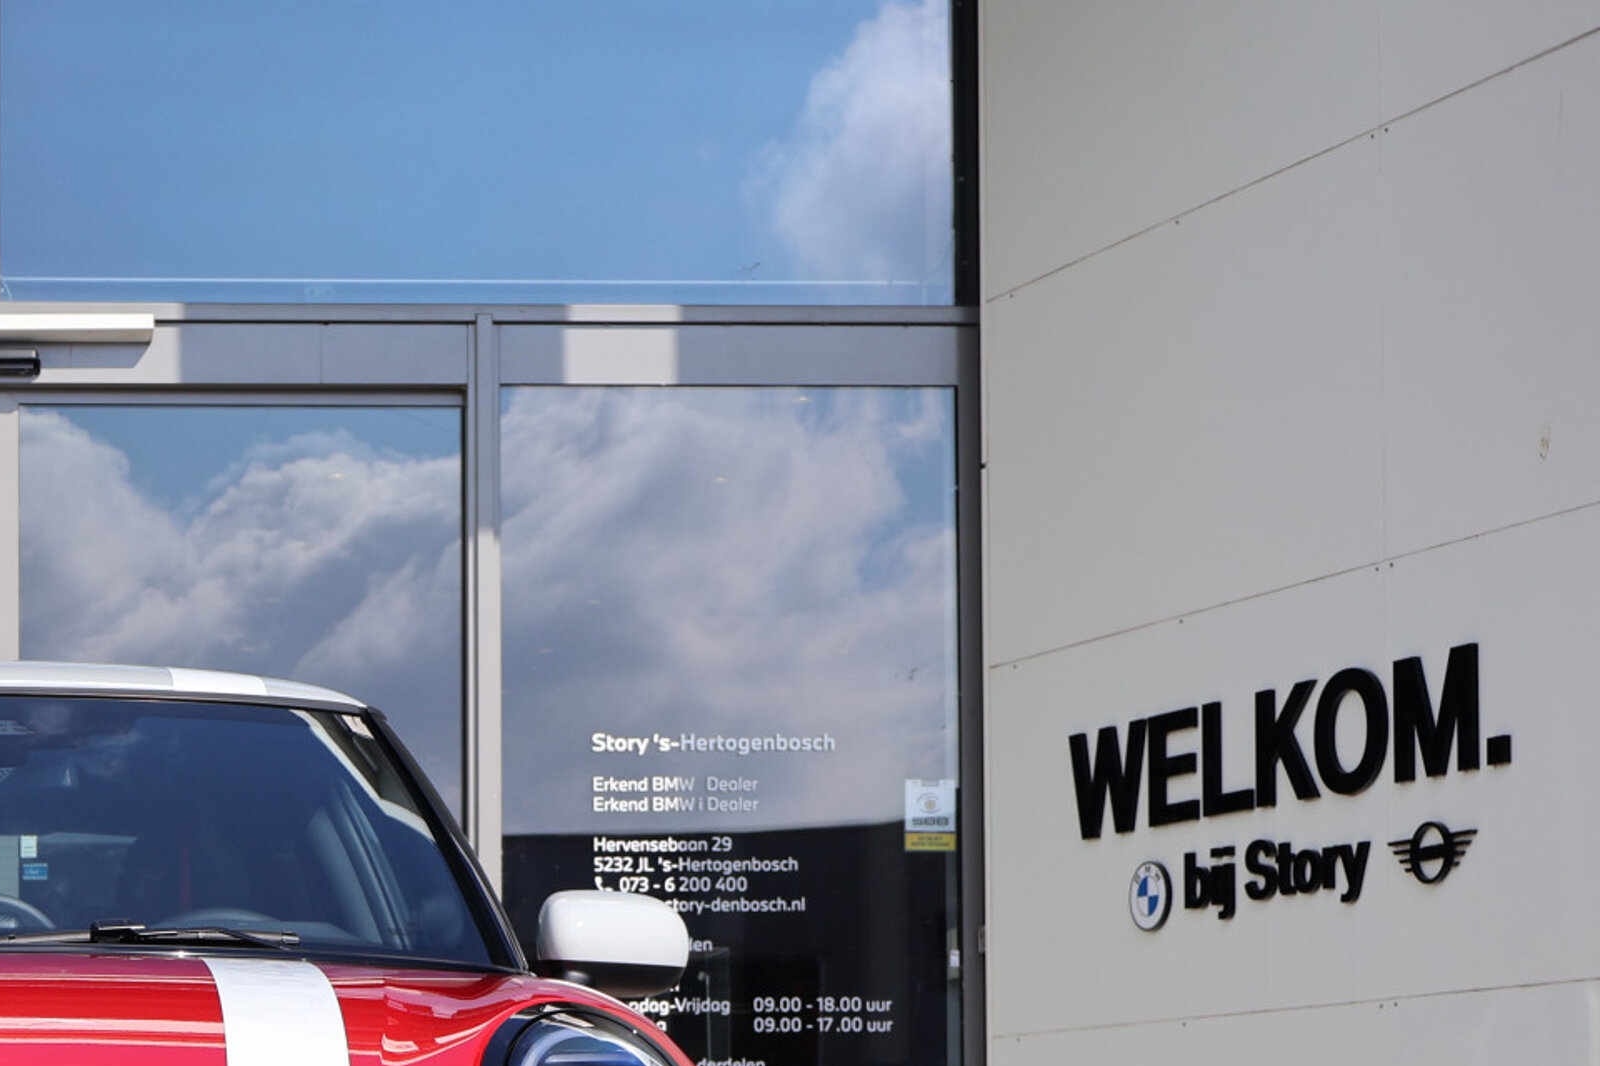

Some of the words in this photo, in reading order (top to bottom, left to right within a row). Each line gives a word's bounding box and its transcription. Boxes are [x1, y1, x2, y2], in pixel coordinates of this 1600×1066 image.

[591, 732, 649, 755] Story
[1068, 641, 1512, 841] WELKOM.
[592, 776, 649, 792] Erkend
[652, 776, 695, 792] BMW
[707, 776, 760, 792] Dealer
[593, 796, 649, 812] Erkend
[652, 796, 695, 812] BMW
[707, 796, 760, 812] Dealer
[593, 836, 708, 853] Hervensebaan
[711, 836, 733, 853] 29
[594, 856, 633, 873] 5232
[636, 856, 654, 873] JL
[619, 876, 649, 892] 073
[664, 876, 676, 892] 6
[678, 876, 710, 892] 200
[715, 876, 748, 892] 400
[1184, 846, 1235, 920] bij
[1245, 839, 1371, 904] Story
[753, 997, 802, 1012] 09.00
[817, 997, 862, 1012] 18.00
[866, 1001, 893, 1012] uur
[753, 1017, 802, 1033] 09.00
[867, 1021, 893, 1033] uur
